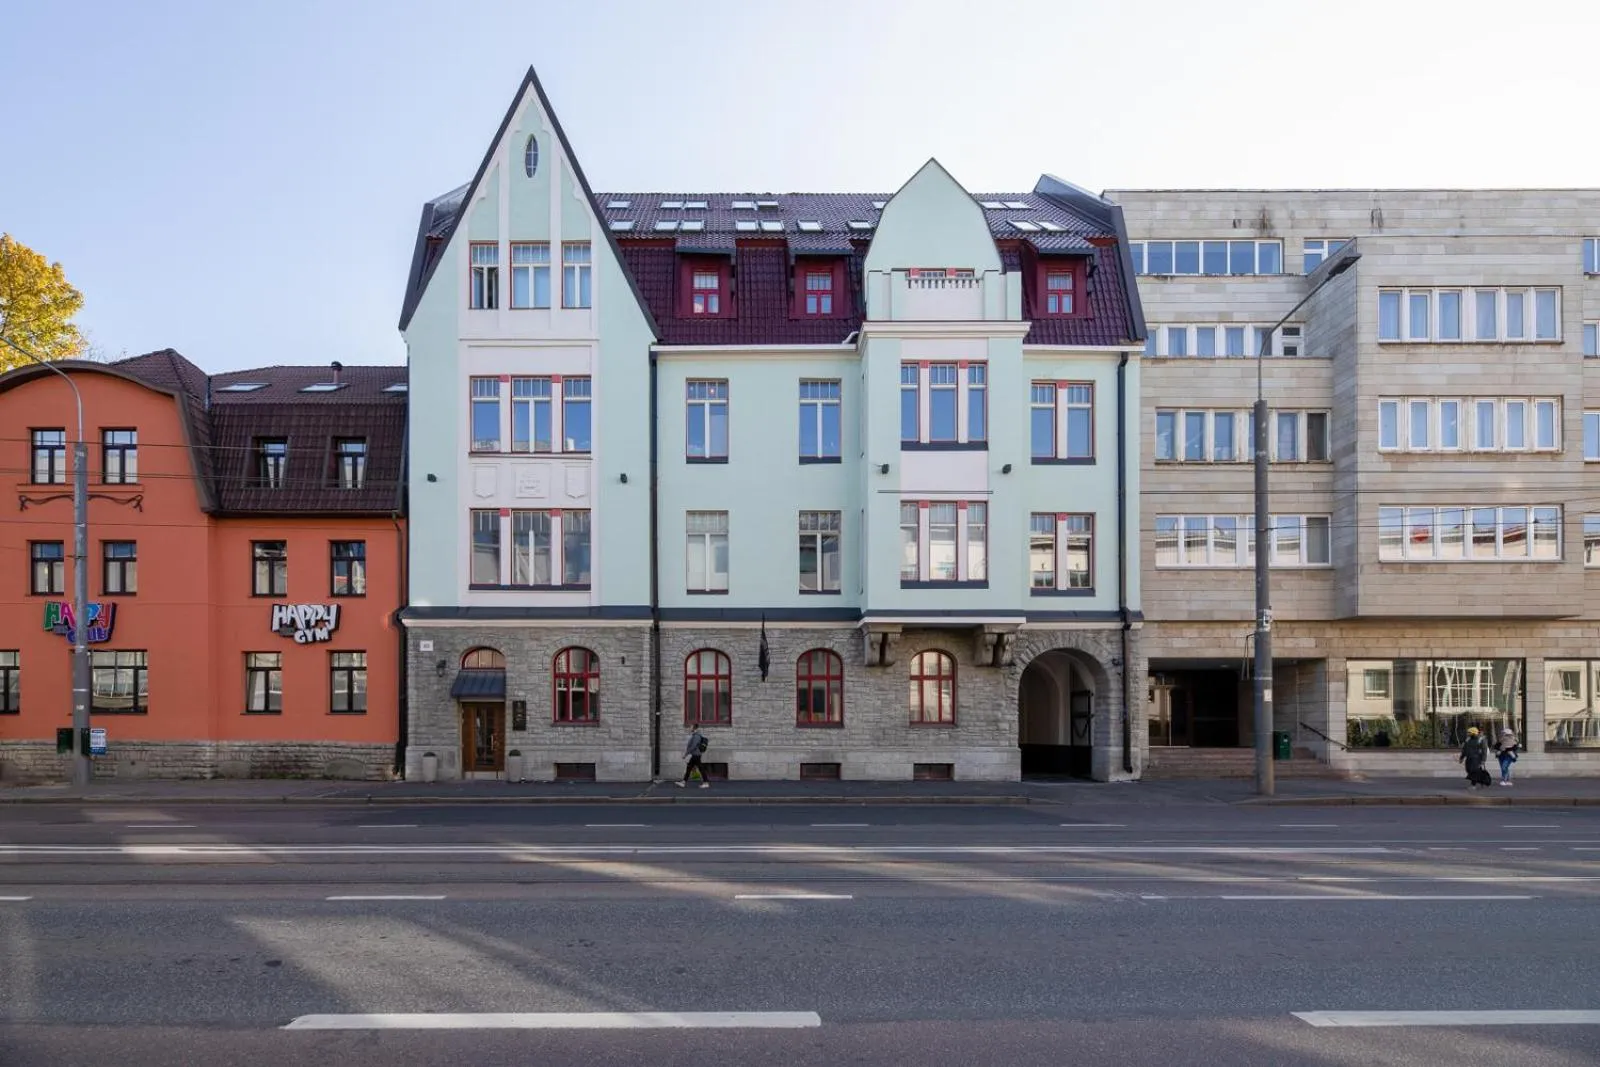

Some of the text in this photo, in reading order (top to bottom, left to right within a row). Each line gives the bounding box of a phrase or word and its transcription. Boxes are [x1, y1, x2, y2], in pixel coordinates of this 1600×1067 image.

[44, 601, 112, 630] HAPY
[271, 603, 338, 632] HAPPY
[294, 627, 329, 644] GYM
